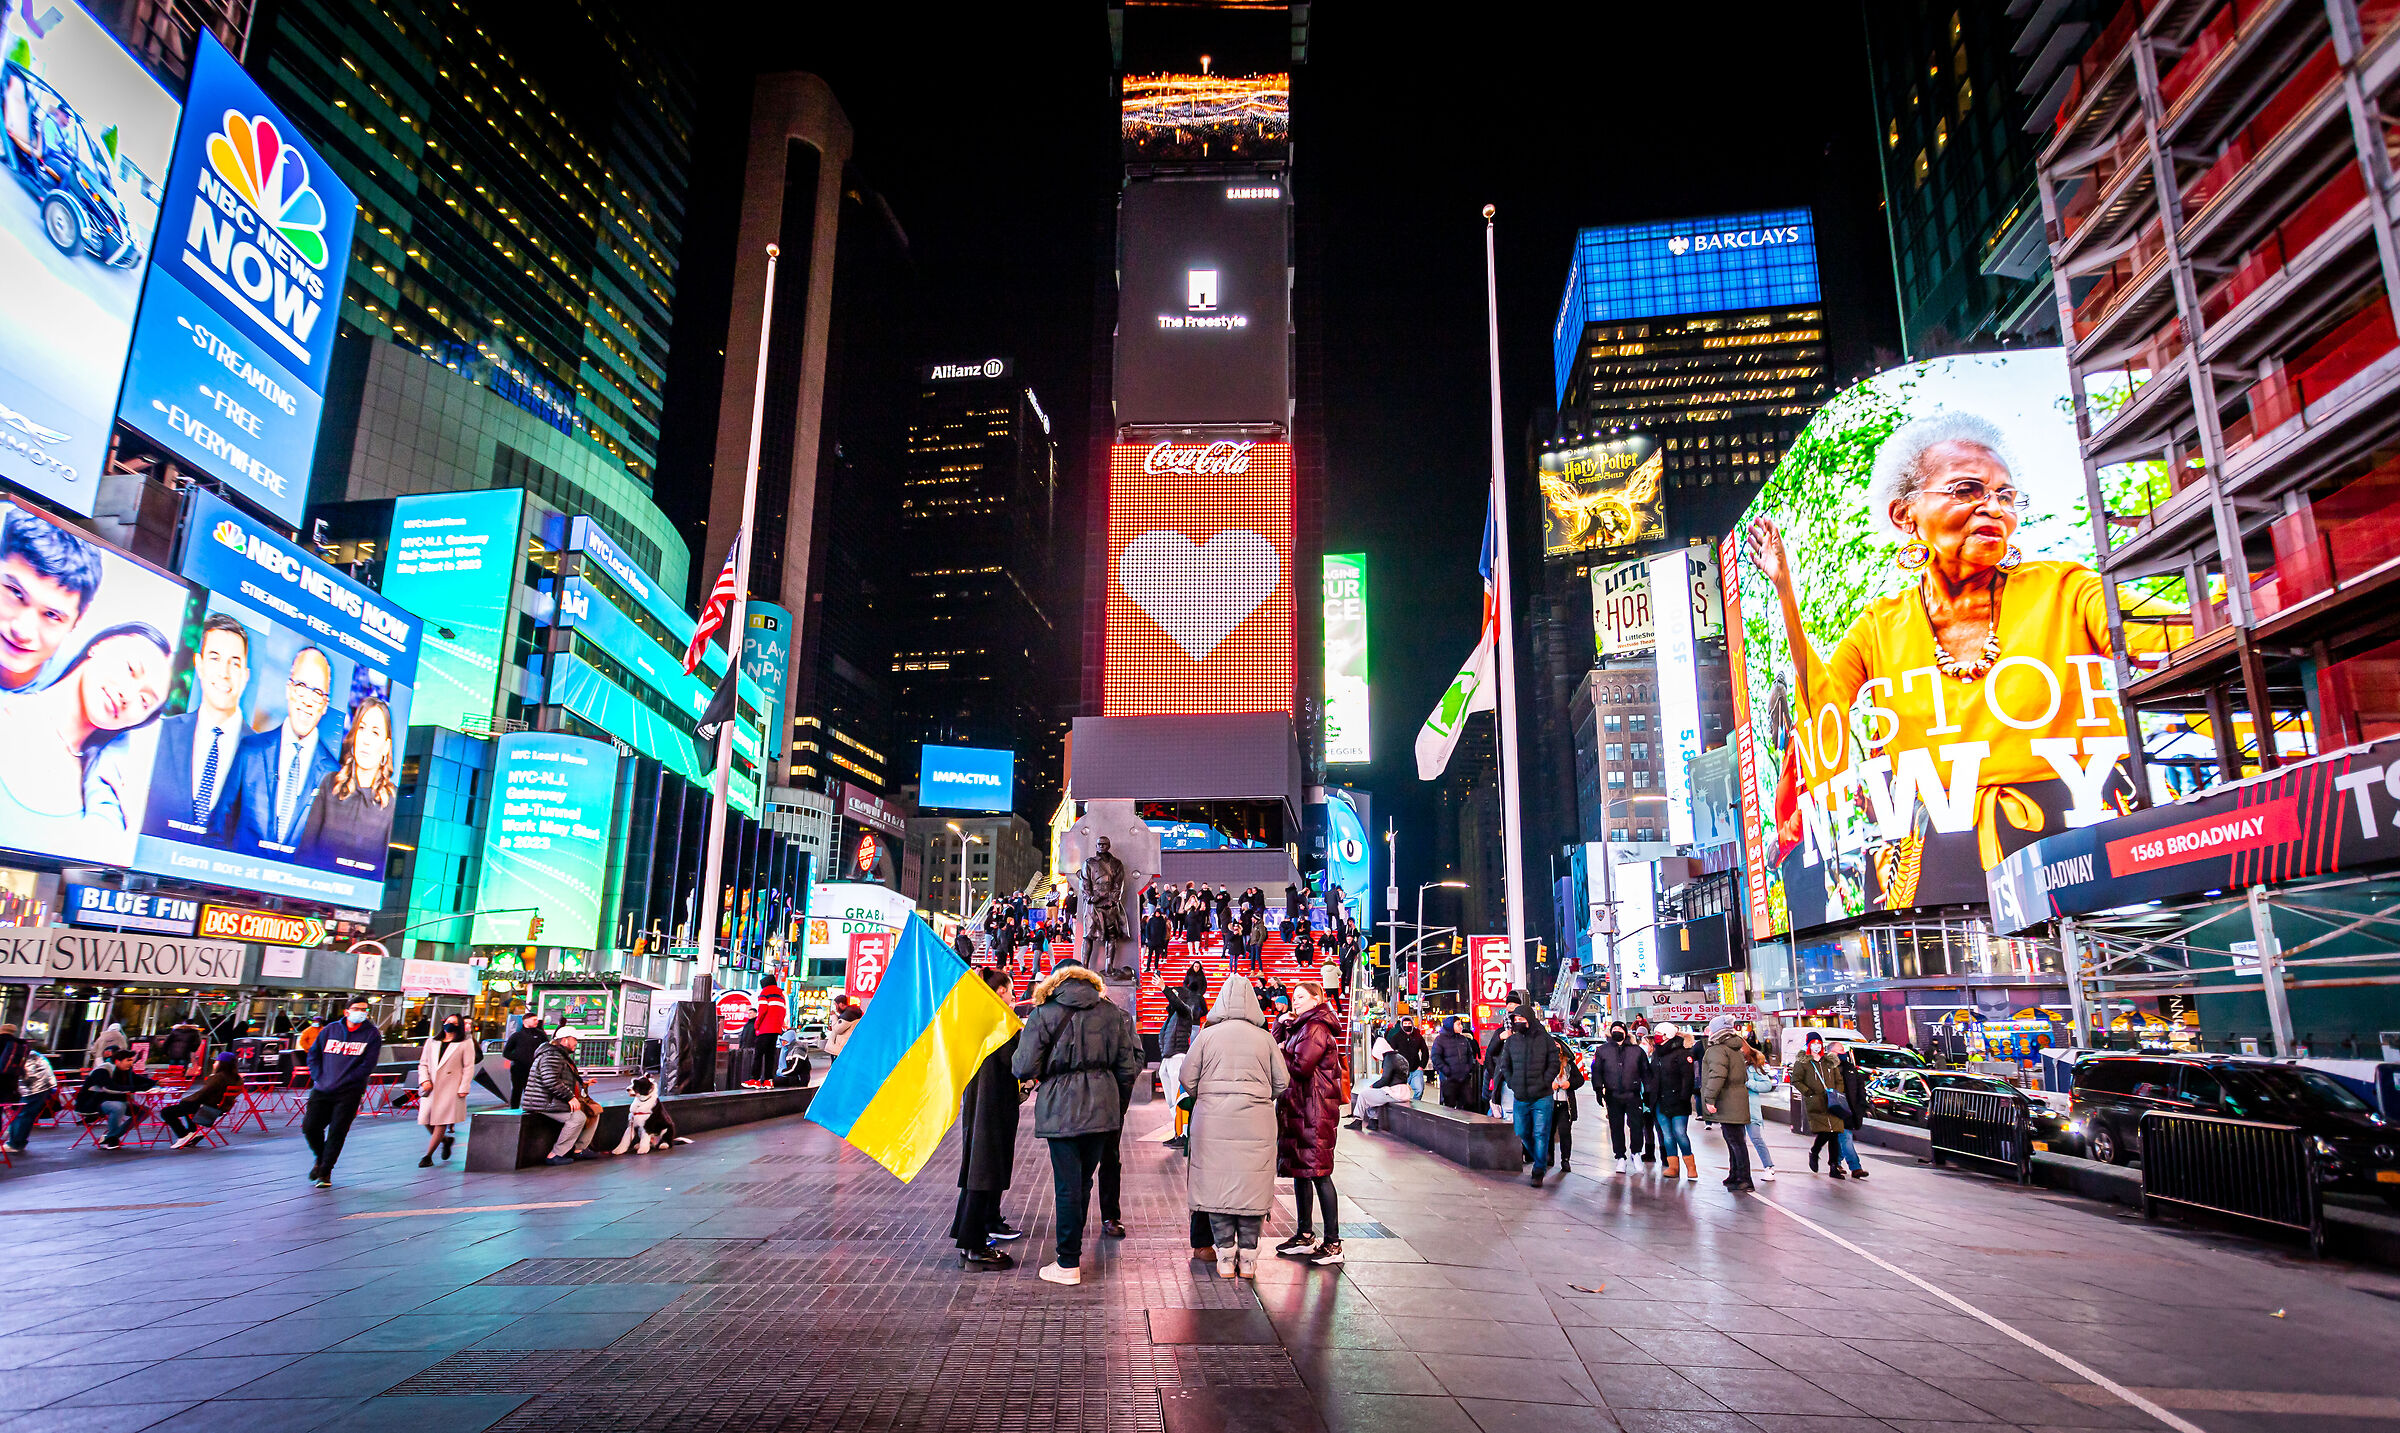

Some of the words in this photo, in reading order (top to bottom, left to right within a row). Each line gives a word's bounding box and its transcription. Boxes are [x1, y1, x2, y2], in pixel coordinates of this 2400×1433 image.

[1227, 188, 1280, 199] SAMSUNG
[197, 166, 257, 235] NBC
[257, 227, 324, 300] NEWS
[1694, 226, 1799, 251] BARCLAYS
[187, 195, 322, 343] NOW
[1158, 316, 1183, 328] The
[1184, 316, 1247, 328] Freestyle
[192, 324, 297, 416] STREAMING
[931, 364, 982, 379] Allianz
[213, 394, 263, 440] FREE
[167, 406, 289, 498] EVERYWHERE
[1144, 440, 1257, 475] Coca-Cola
[1583, 440, 1631, 454] BROADWAY
[1562, 458, 1599, 482] Harry
[1599, 452, 1638, 477] Potter
[1578, 476, 1603, 485] CURSED
[1604, 472, 1625, 480] CHILD
[397, 563, 418, 574] May
[418, 562, 443, 572] Start
[589, 531, 609, 560] NYC
[608, 551, 629, 581] Local
[246, 534, 300, 583] NBC
[300, 566, 363, 618] NEWS
[361, 601, 409, 643] NOW
[1605, 562, 1650, 596] LITTL
[240, 580, 298, 619] STREAMING
[307, 615, 333, 636] FREE
[744, 638, 785, 664] PLAY
[747, 661, 781, 686] NPR
[511, 750, 531, 760] NYC
[1790, 703, 1842, 787] NO
[508, 771, 568, 786] NYC-N.J.
[933, 771, 1001, 787] IMPACTFUL
[1738, 721, 1761, 838] HERSHEY'S
[506, 786, 567, 804] Gateway
[1797, 741, 1991, 868] NEW
[504, 803, 581, 821] Rail-Tunnel
[500, 835, 511, 849] in
[502, 819, 536, 832] Work
[539, 820, 570, 837] May
[572, 824, 600, 841] Start
[2131, 842, 2164, 862] 1568
[2168, 816, 2265, 855] BROADWAY
[170, 852, 209, 871] Learn
[213, 861, 242, 876] more
[244, 867, 259, 880] at
[1747, 846, 1766, 918] STORE
[81, 887, 149, 916] BLUE
[156, 897, 198, 921] FIN
[845, 908, 880, 920] GRAB
[205, 910, 239, 935] DOS
[241, 915, 304, 942] CAMINOS
[52, 935, 242, 979] SWAROVSKI
[856, 937, 884, 992] tkts
[1482, 941, 1512, 1000] tkts
[478, 968, 550, 982] BROADWAY
[553, 971, 573, 982] UP
[575, 971, 621, 982] CLOSE
[720, 1004, 746, 1012] COVID-19
[1872, 992, 1878, 1000] X
[624, 1026, 646, 1037] SECRETS
